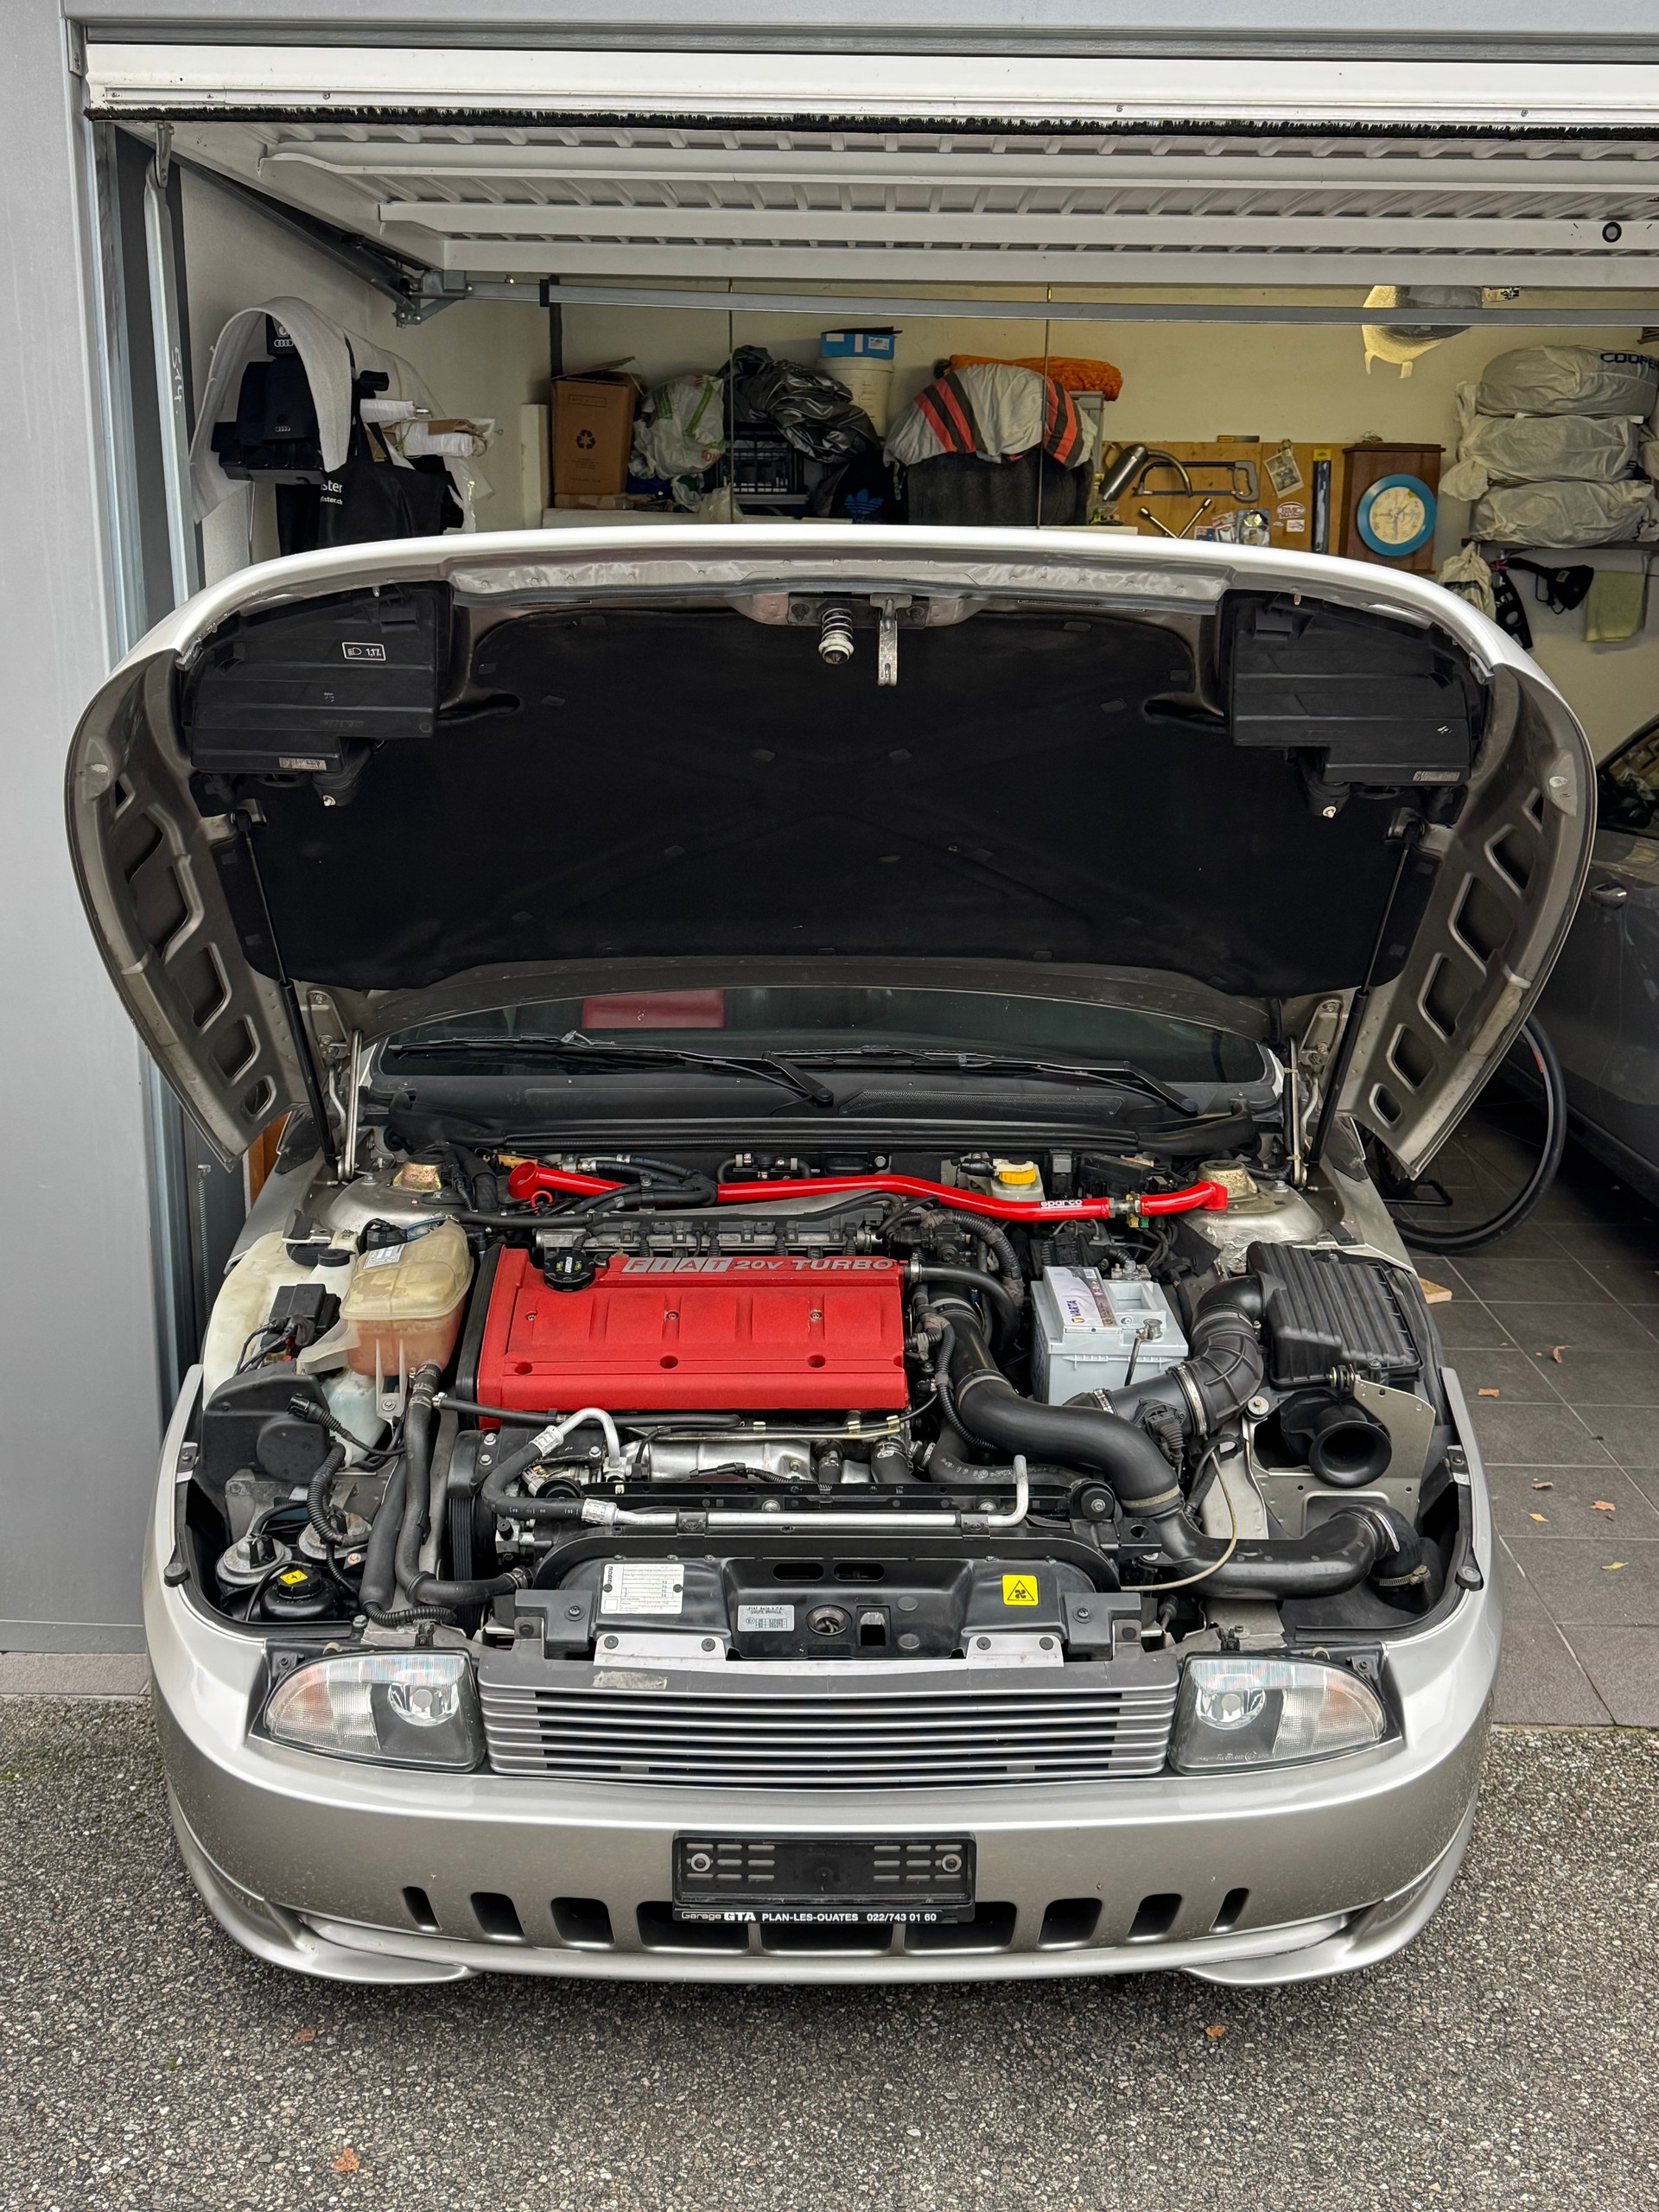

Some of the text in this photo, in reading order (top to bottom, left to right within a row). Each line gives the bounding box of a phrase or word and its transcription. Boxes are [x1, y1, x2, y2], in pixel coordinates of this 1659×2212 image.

[1040, 1199, 1083, 1209] sparco
[626, 1258, 729, 1272] FIAT
[791, 1259, 893, 1271] TURBO
[1065, 1300, 1082, 1318] VARTA
[681, 1911, 938, 1923] Garage GTA PLAN-LES-OUATES 022/743 01 60
